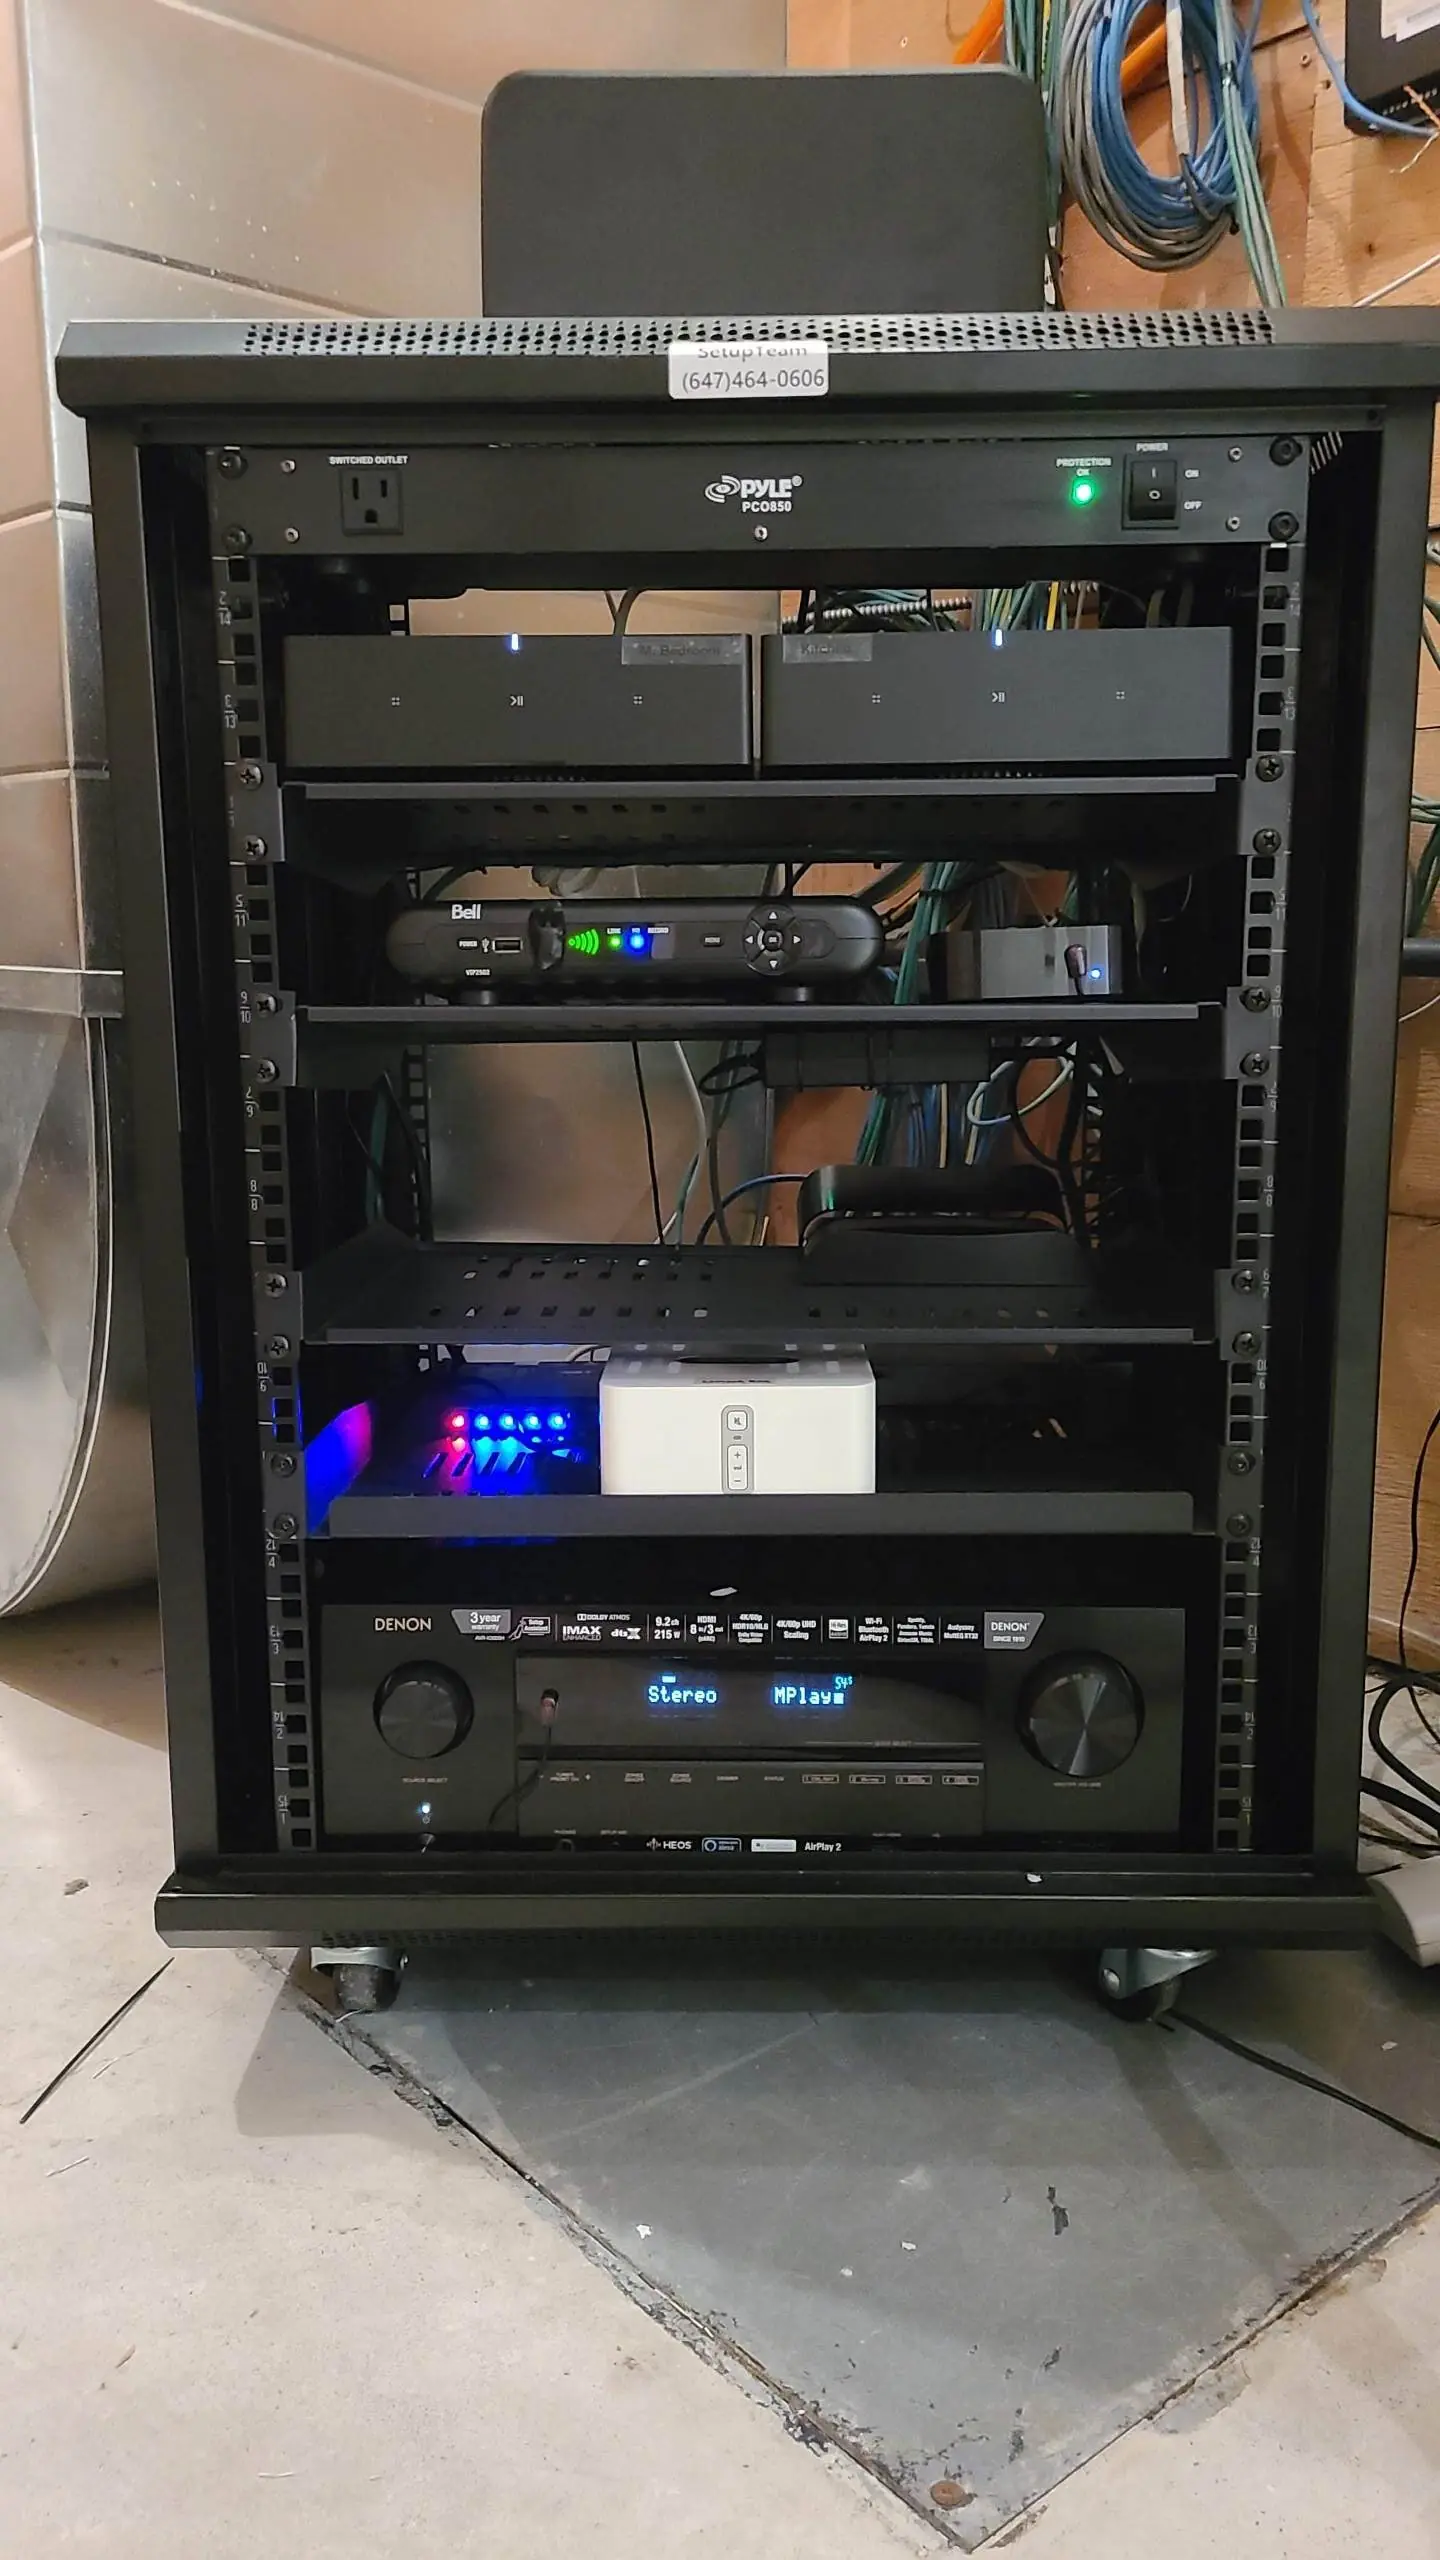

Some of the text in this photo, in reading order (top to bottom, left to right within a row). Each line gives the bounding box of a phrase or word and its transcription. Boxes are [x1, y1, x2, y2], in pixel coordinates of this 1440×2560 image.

[682, 369, 825, 393] (647)464-0606
[329, 455, 408, 464] SWITCHED OUTLET
[1056, 458, 1111, 466] PROTECTION
[451, 904, 482, 919] Bell
[470, 1612, 502, 1624] 3 year
[865, 1617, 883, 1625] Wi-Fi
[374, 1617, 432, 1631] DENON
[801, 1620, 816, 1628] UHD
[991, 1622, 1028, 1631] DENON
[563, 1626, 603, 1635] IMAX
[654, 1630, 672, 1639] 215
[783, 1631, 809, 1640] Scaling
[859, 1634, 882, 1642] AirPlay
[648, 1686, 717, 1704] Stereo
[774, 1686, 832, 1704] MPlay
[663, 1842, 692, 1850] HEOS
[804, 1843, 842, 1851] AirPlay 2
